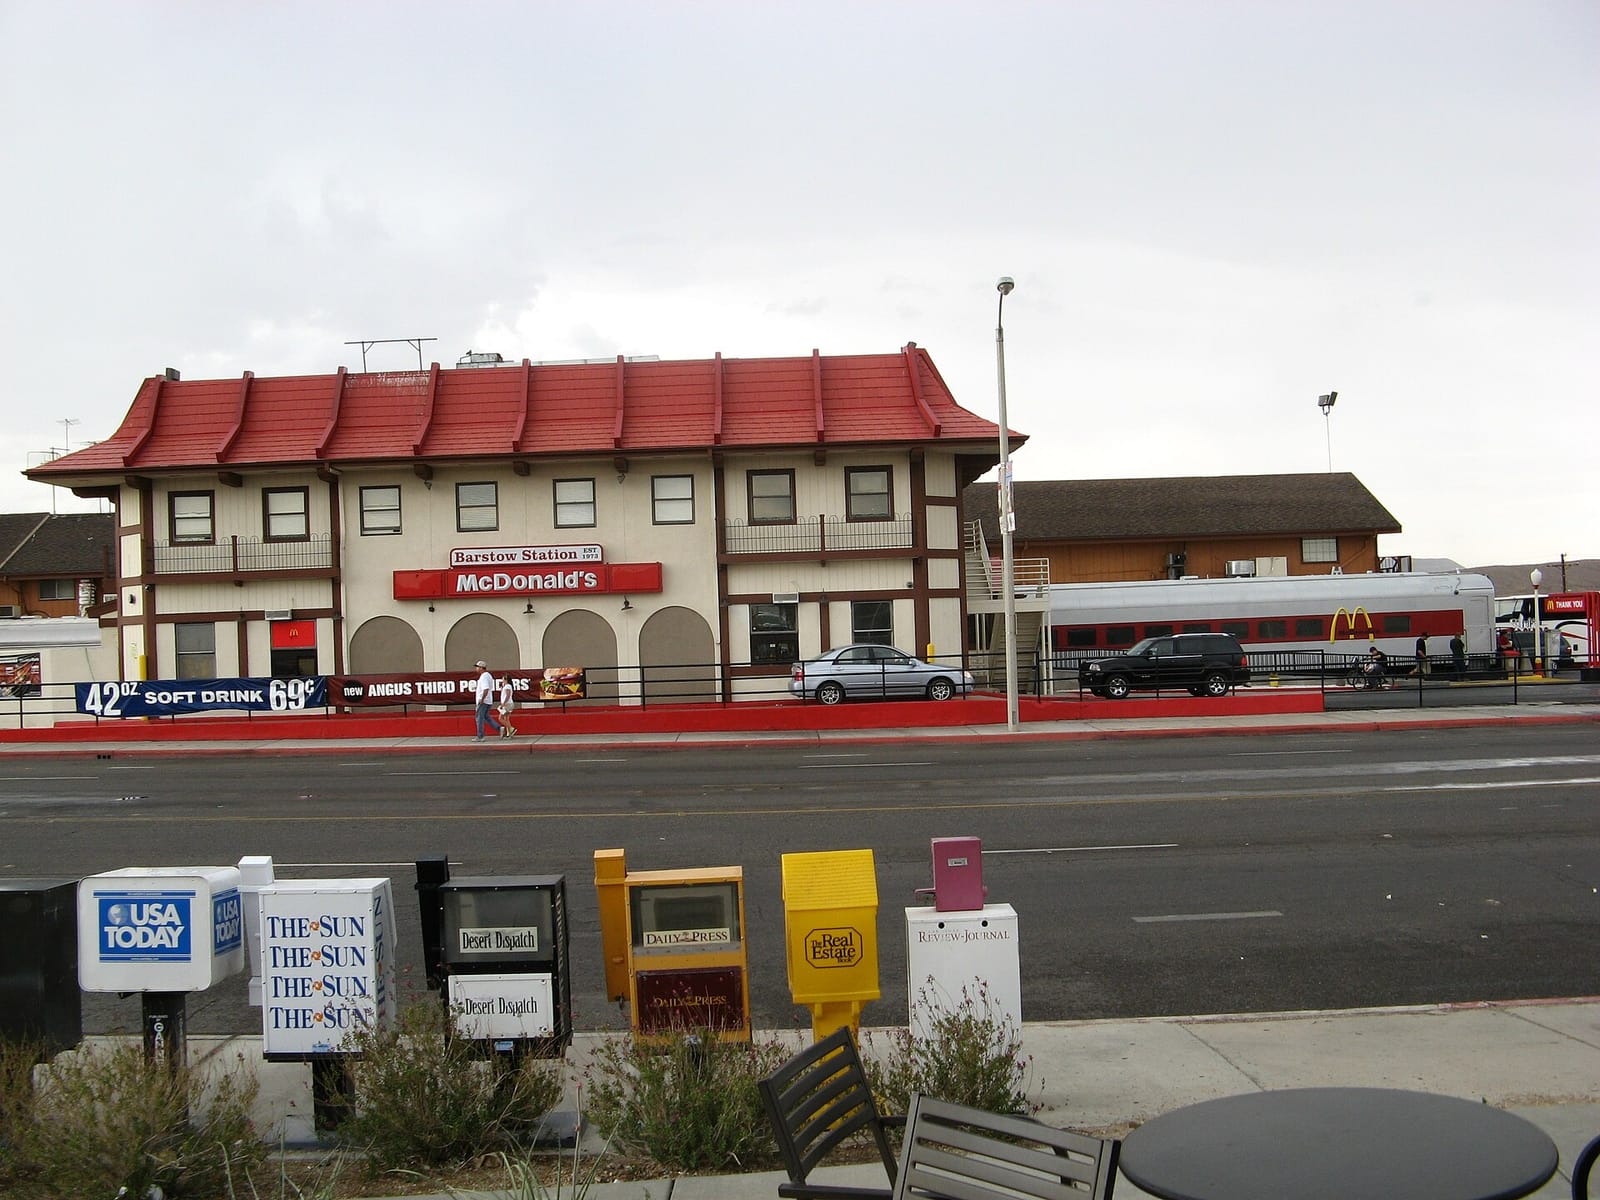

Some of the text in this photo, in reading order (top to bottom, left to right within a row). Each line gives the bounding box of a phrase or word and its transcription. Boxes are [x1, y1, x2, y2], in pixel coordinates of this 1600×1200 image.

[454, 549, 578, 563] Barstow Station
[456, 571, 598, 592] McDonald's
[1555, 600, 1572, 609] THANK
[1572, 600, 1583, 608] YOU
[85, 682, 122, 716] 42
[145, 690, 197, 705] SOFT
[201, 689, 264, 704] DRINK
[269, 679, 315, 711] 69¢
[343, 686, 363, 697] new
[368, 681, 412, 697] ANGUS
[415, 680, 455, 695] THIRD
[130, 903, 182, 926] USA
[223, 899, 238, 920] USA
[215, 917, 240, 944] TODAY
[267, 914, 365, 938] THE SUN
[104, 926, 185, 949] TODAY
[462, 930, 535, 951] Desert Dispatch
[646, 931, 728, 945] DAILY PRESS
[821, 931, 854, 948] Real
[269, 944, 367, 968] THE SUN
[812, 945, 857, 960] Estate
[270, 975, 368, 998] THE SUN
[465, 996, 538, 1017] Desert Dispatch
[269, 1007, 315, 1029] THE
